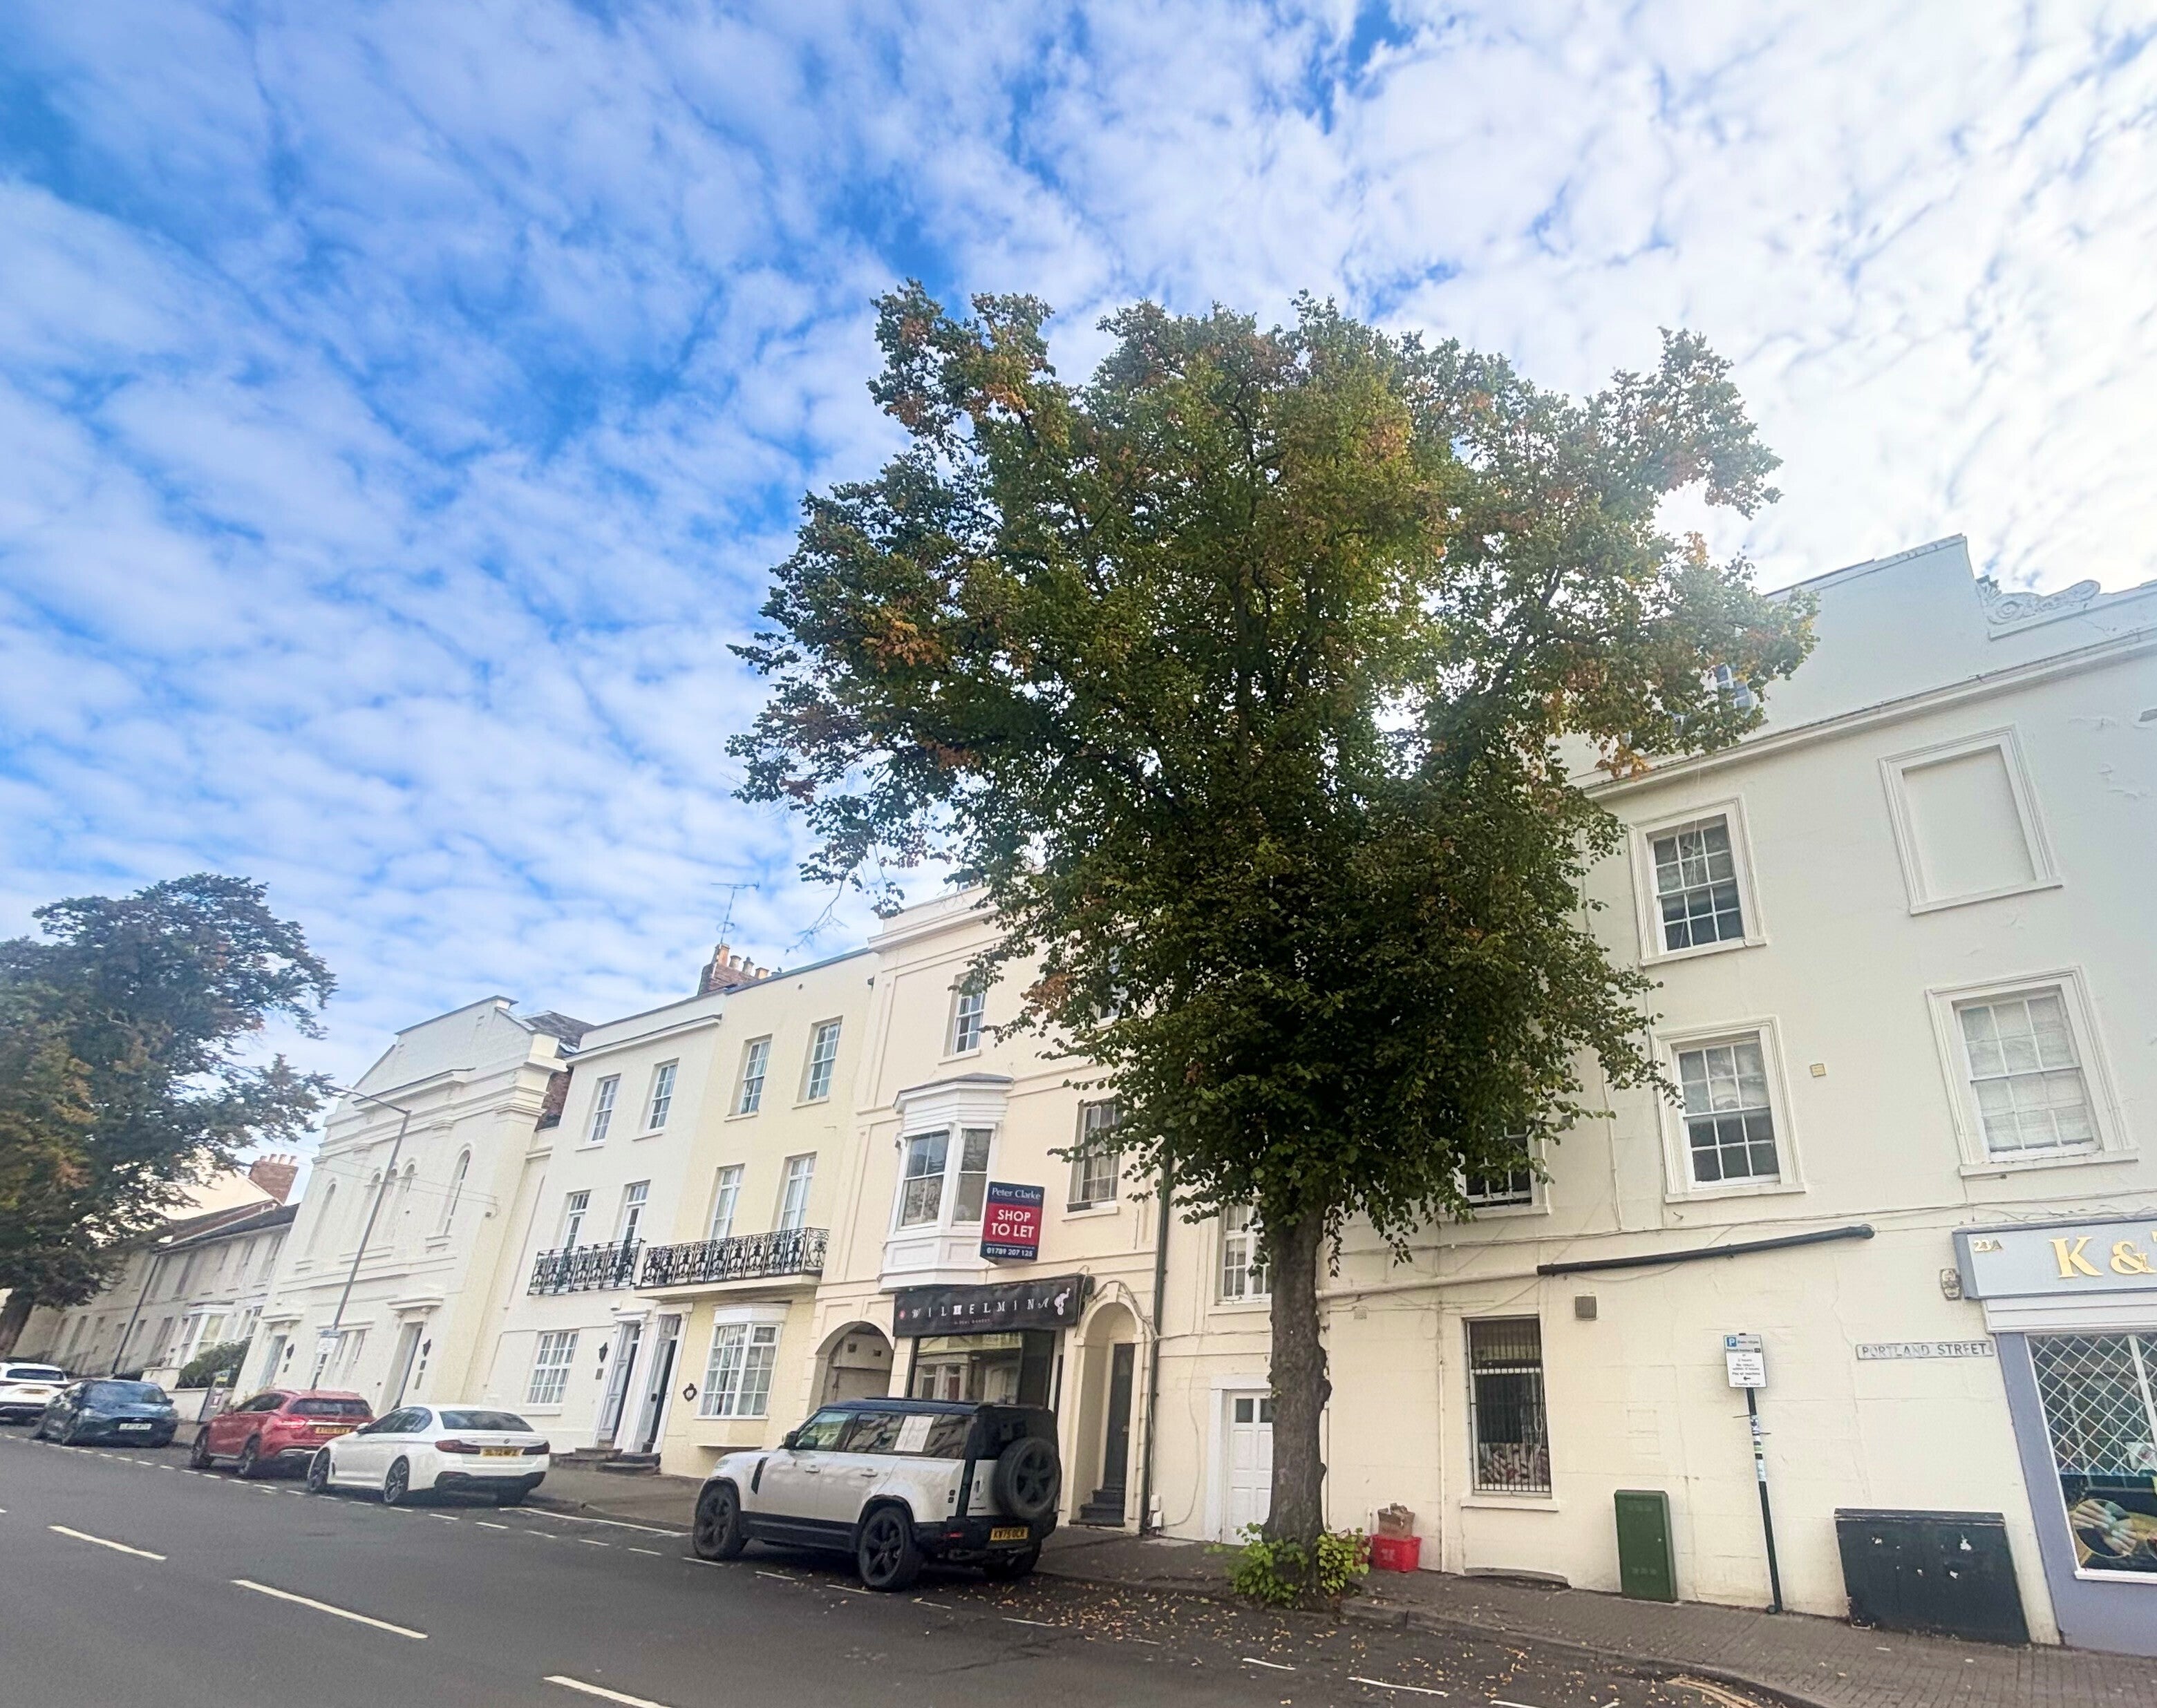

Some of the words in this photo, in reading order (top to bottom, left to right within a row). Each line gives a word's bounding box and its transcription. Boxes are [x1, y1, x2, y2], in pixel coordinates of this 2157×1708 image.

[991, 1187, 1013, 1197] Peter
[1015, 1189, 1042, 1200] Clarke
[997, 1209, 1032, 1222] SHOP
[991, 1222, 1010, 1235] TO
[1012, 1224, 1035, 1238] LET
[1974, 1239, 2004, 1253] 23A
[2048, 1236, 2104, 1279] K
[2110, 1241, 2157, 1275] &
